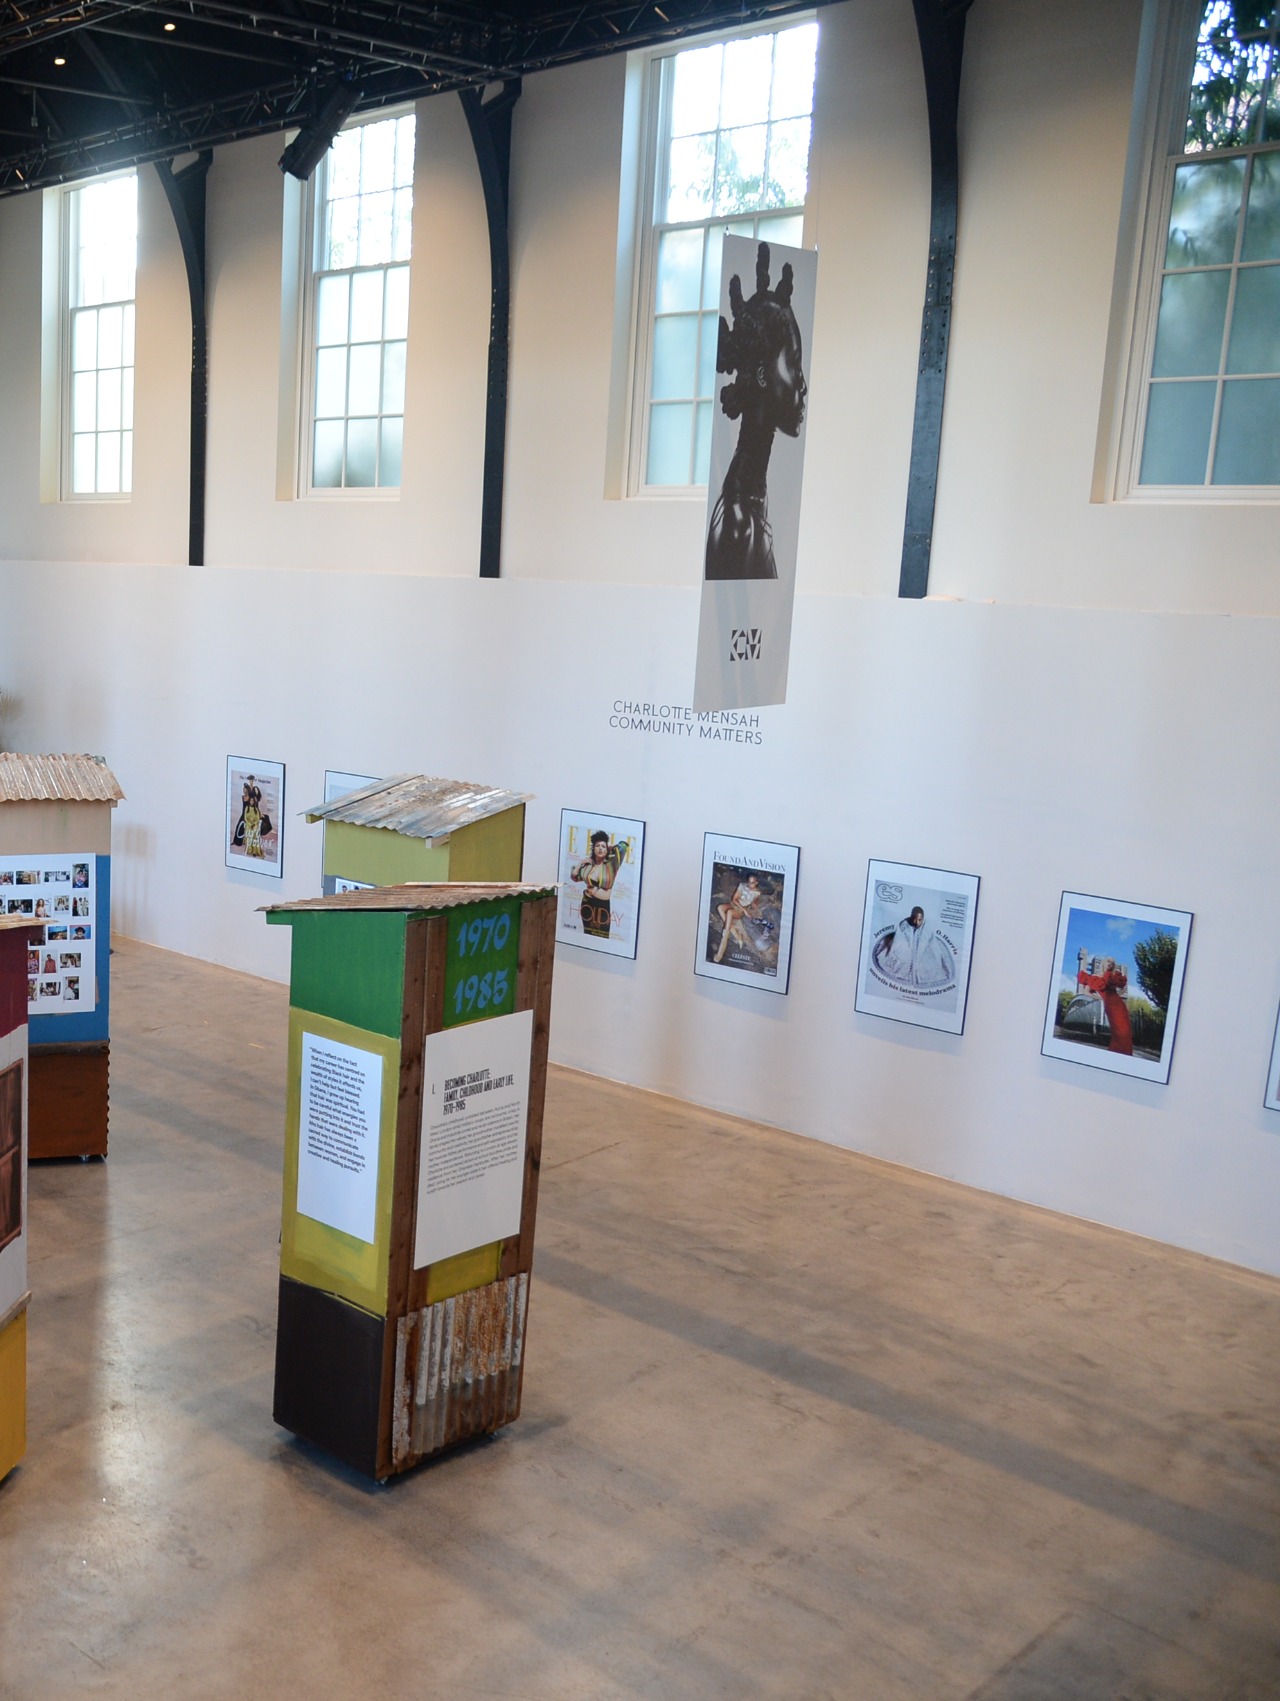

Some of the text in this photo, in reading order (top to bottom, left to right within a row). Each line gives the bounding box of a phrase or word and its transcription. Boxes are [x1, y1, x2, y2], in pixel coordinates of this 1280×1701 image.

[613, 700, 760, 728] CHARLOTTE MENSAH
[609, 715, 763, 745] COMMUNITY MATTERS
[876, 883, 903, 902] es
[569, 901, 625, 927] HOLIDAY
[456, 913, 511, 957] 1970
[874, 924, 895, 938] Jeremy
[943, 934, 958, 955] Harris
[453, 968, 509, 1015] 1985
[869, 967, 956, 996] unveils his latest melodrama
[444, 1074, 466, 1091] BECOMING
[459, 1082, 483, 1099] CHILDHOOD
[483, 1079, 493, 1093] AND
[493, 1076, 505, 1090] EARLY
